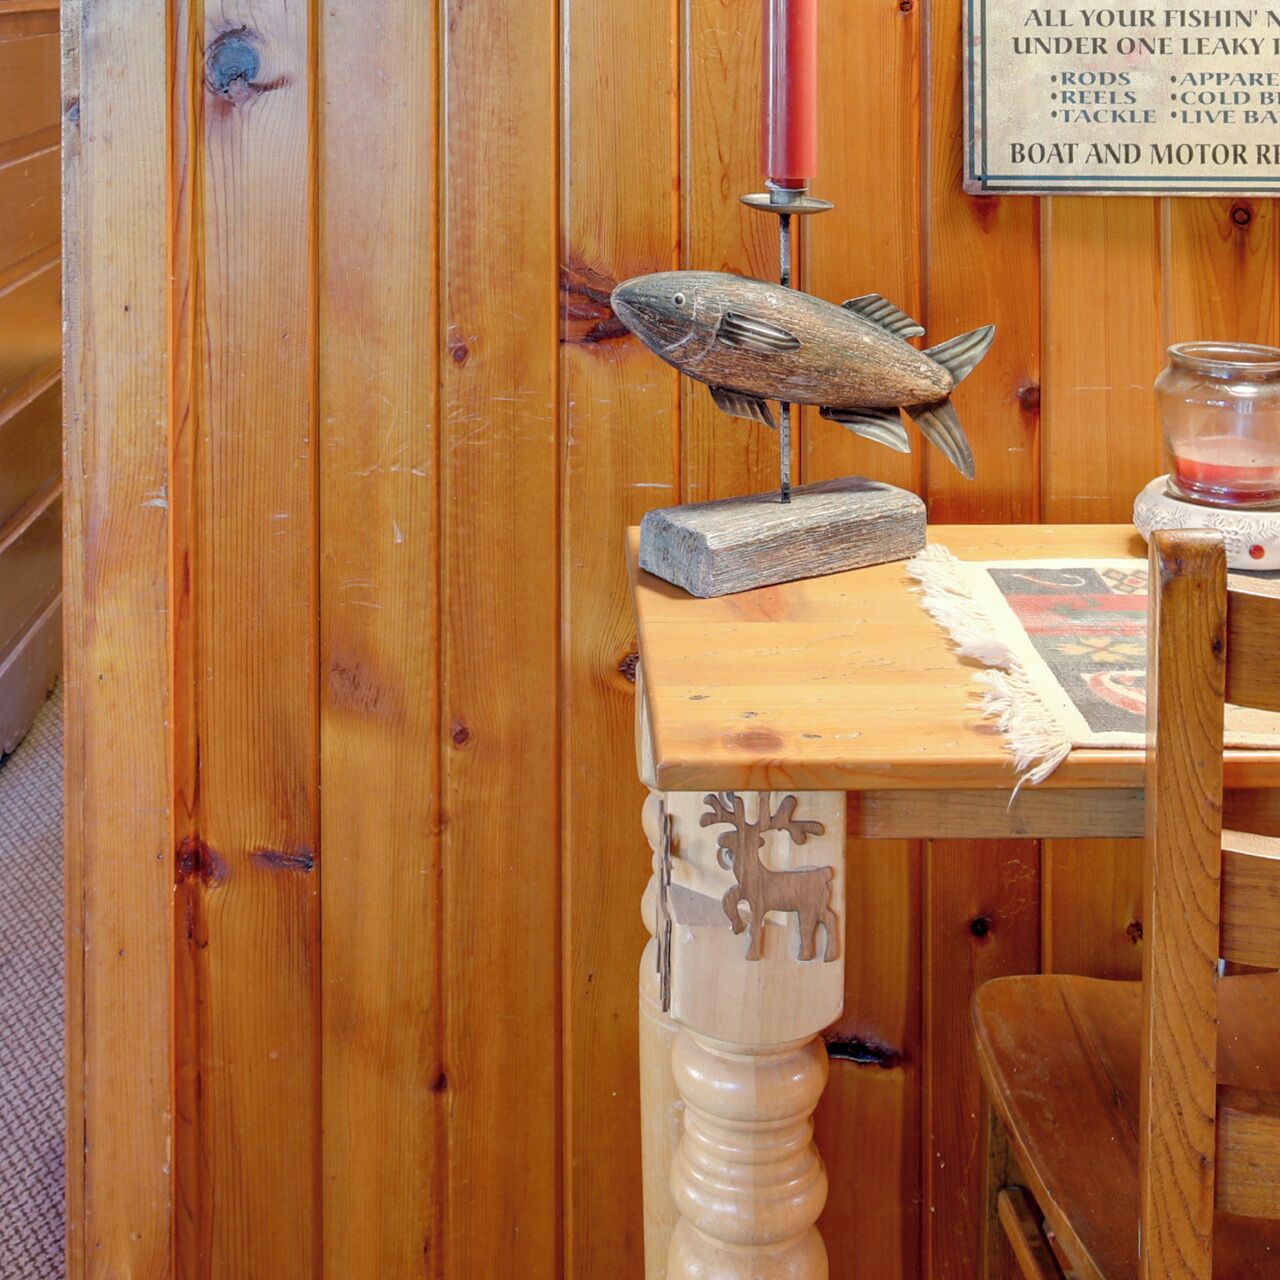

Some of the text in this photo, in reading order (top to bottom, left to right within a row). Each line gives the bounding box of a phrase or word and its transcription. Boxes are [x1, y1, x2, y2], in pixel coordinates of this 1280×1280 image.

[1023, 9, 1074, 27] ALL
[1080, 9, 1157, 28] YOUR
[1164, 8, 1258, 28] FISHIN'
[1012, 36, 1108, 56] UNDER
[1116, 36, 1173, 56] ONE
[1182, 37, 1265, 56] LEAKY
[1060, 71, 1131, 86] RODS
[1060, 90, 1137, 105] REELS
[1180, 91, 1251, 105] COLD
[1059, 109, 1157, 124] TACKLE
[1180, 110, 1236, 124] LIVE
[1009, 142, 1079, 164] BOAT
[1085, 143, 1141, 164] AND
[1150, 143, 1248, 165] MOTOR
